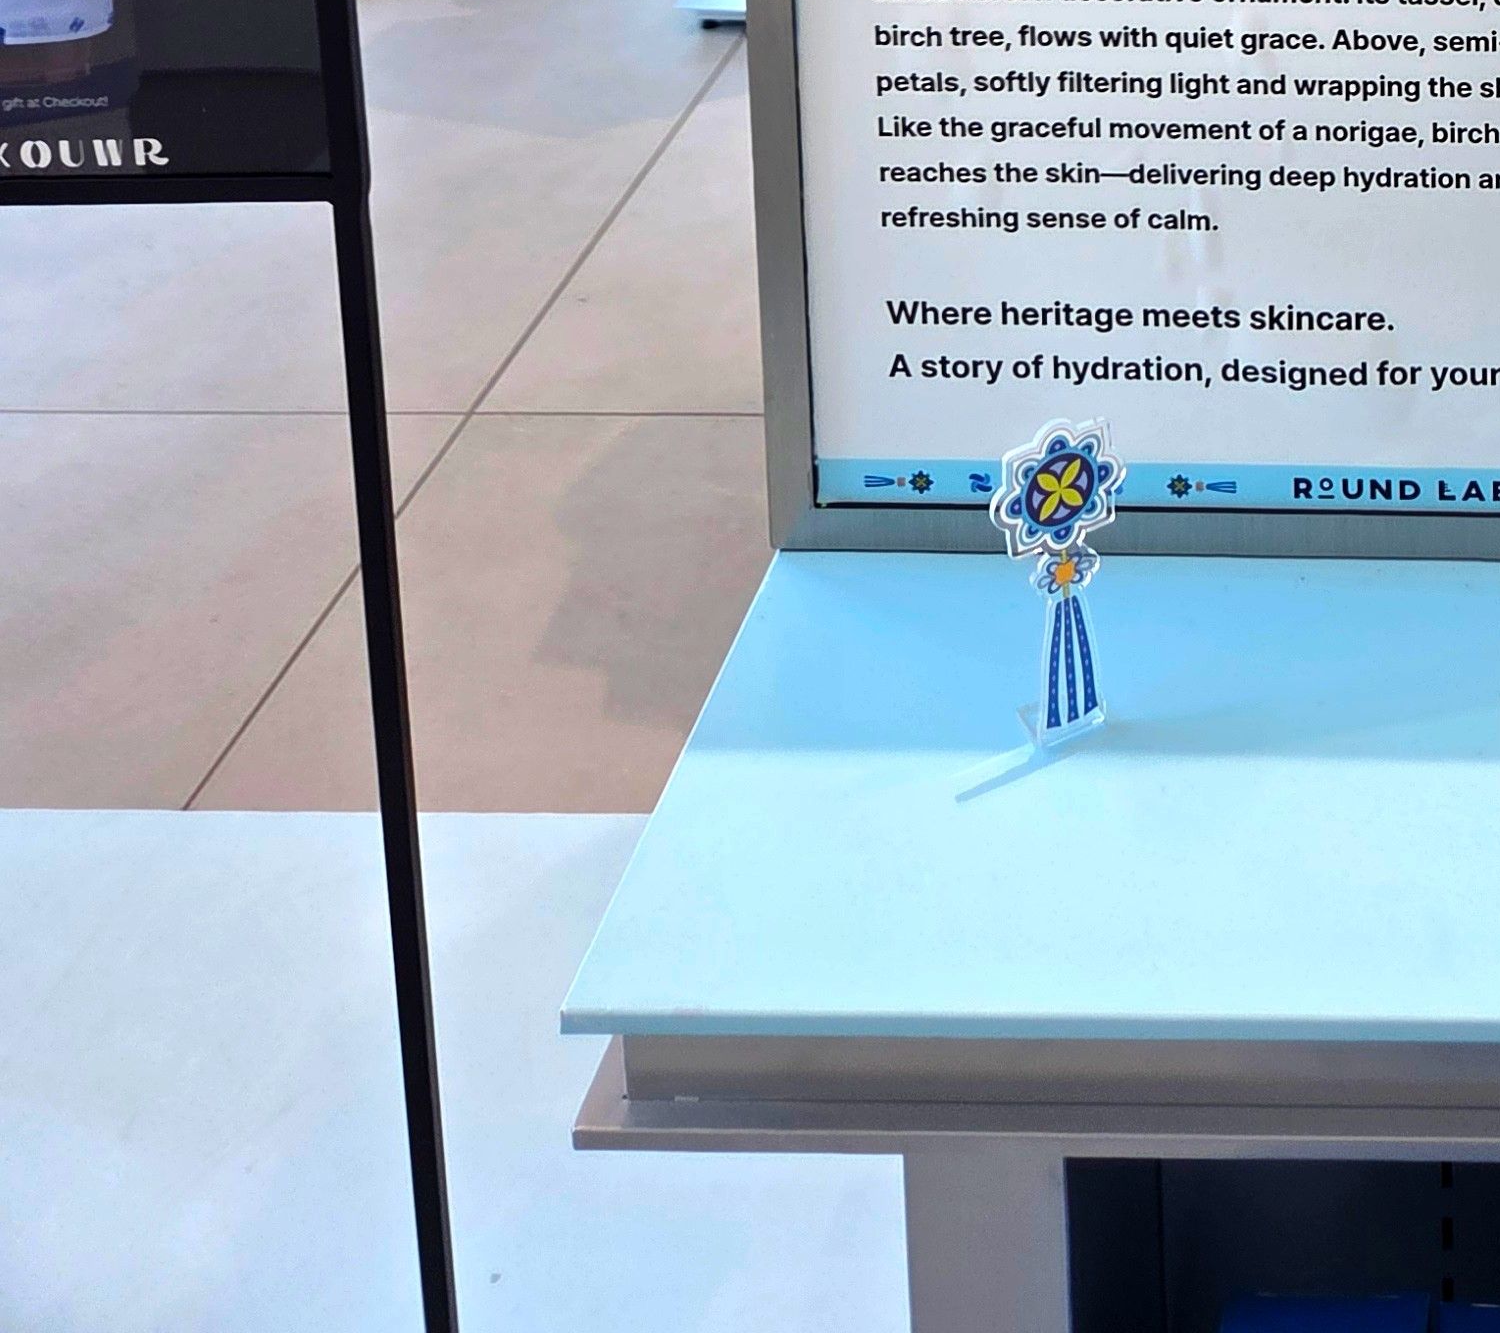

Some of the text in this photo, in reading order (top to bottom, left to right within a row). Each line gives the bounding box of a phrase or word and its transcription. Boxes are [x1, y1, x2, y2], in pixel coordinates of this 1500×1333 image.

[877, 114, 933, 138] Like
[937, 115, 985, 138] the
[990, 115, 1102, 143] graceful
[1108, 119, 1253, 141] movement
[1258, 118, 1287, 142] of
[1291, 124, 1308, 142] a
[1314, 119, 1425, 149] norigae,
[1431, 120, 1500, 145] birch
[879, 161, 988, 184] reaches
[992, 161, 1039, 184] the
[1268, 164, 1337, 193] deep
[1343, 165, 1472, 194] hydration
[881, 205, 1220, 234] refreshing sense of calm.
[885, 300, 1395, 334] Where heritage meets skincare.
[888, 353, 913, 378] A
[920, 355, 1004, 386] story
[1011, 353, 1044, 380] of
[1052, 354, 1212, 389] hydration,
[1220, 357, 1368, 392] designed
[1375, 359, 1423, 386] for
[1293, 477, 1421, 501] ROUND
